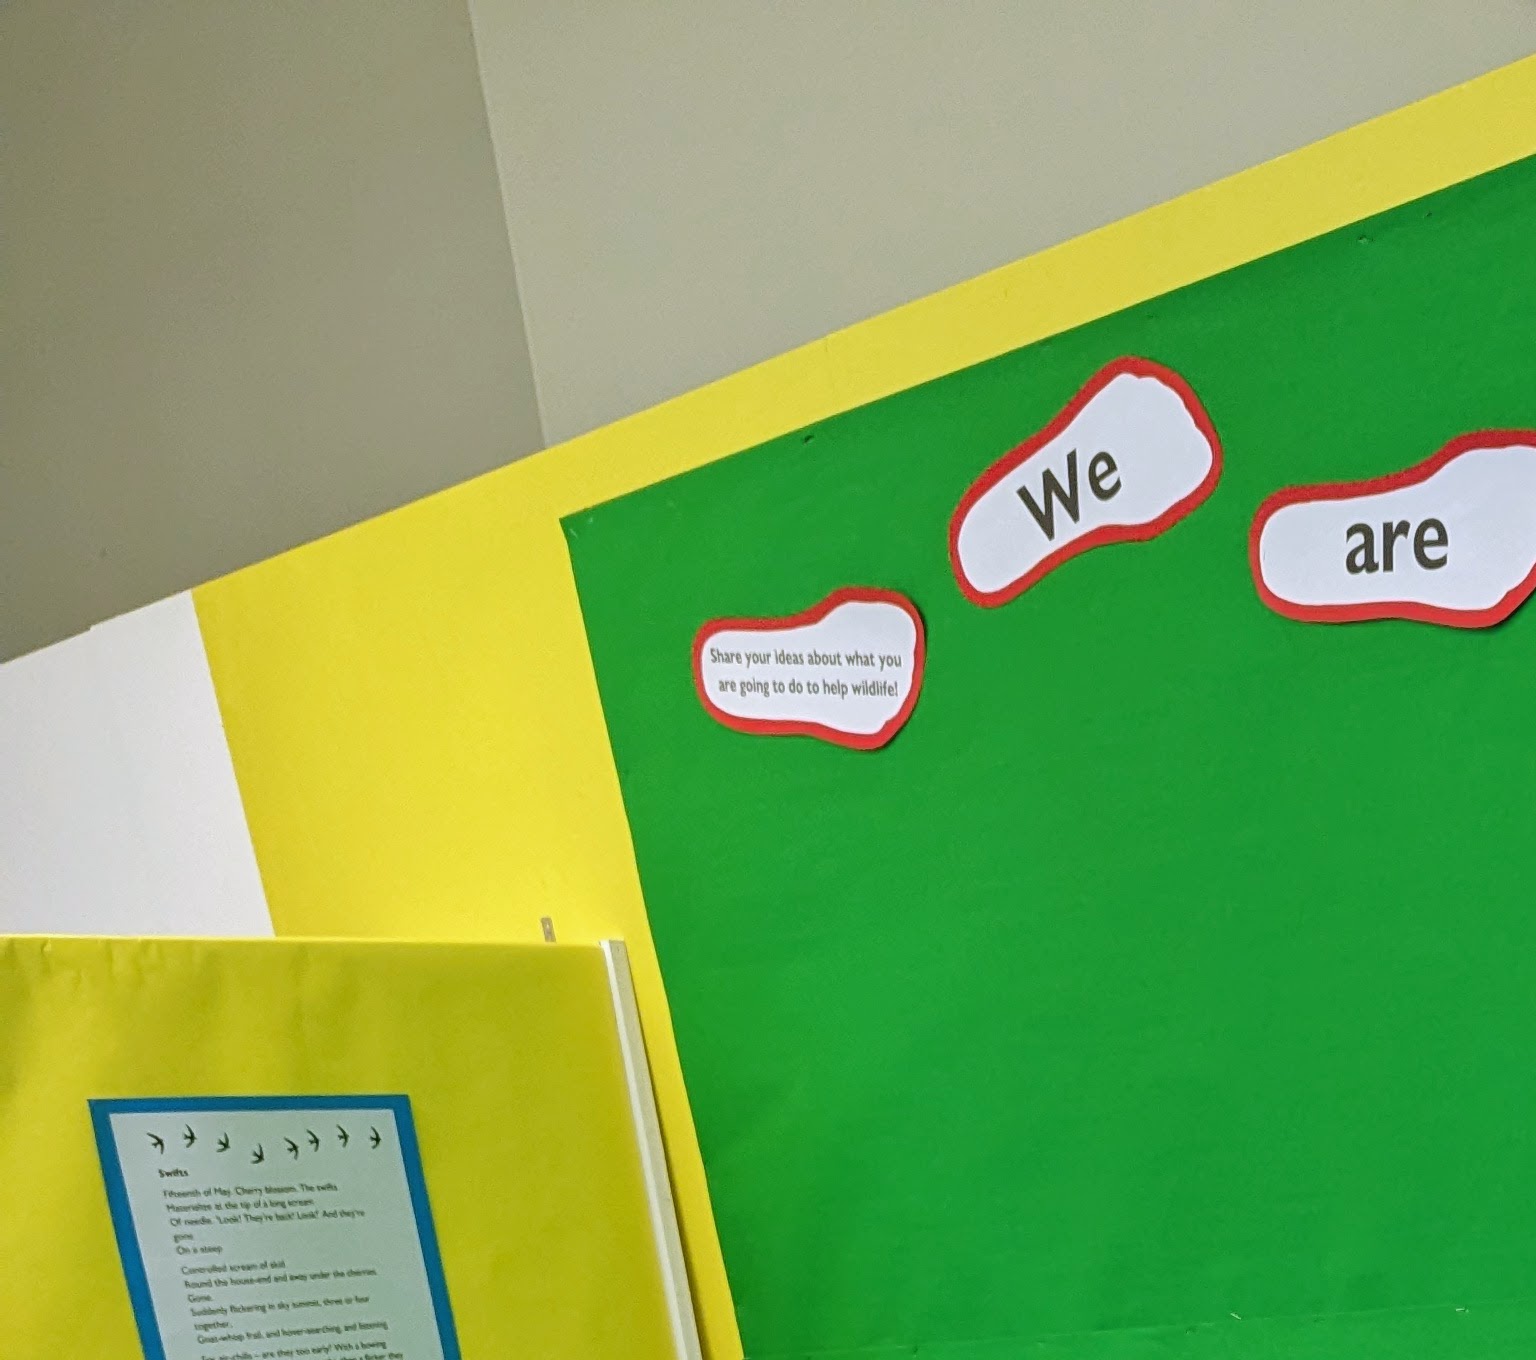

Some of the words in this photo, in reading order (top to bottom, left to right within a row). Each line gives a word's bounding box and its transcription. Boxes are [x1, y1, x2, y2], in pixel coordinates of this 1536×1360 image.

[1017, 445, 1124, 541] We
[1342, 507, 1449, 575] are
[710, 648, 742, 665] Share
[746, 651, 770, 668] your
[807, 650, 842, 666] about
[846, 651, 875, 667] what
[878, 654, 902, 671] you
[718, 679, 737, 692] are
[740, 677, 770, 697] going
[773, 679, 785, 694] to
[788, 678, 803, 695] do
[807, 680, 820, 695] to
[823, 679, 848, 700] help
[852, 680, 899, 697] wildlife!
